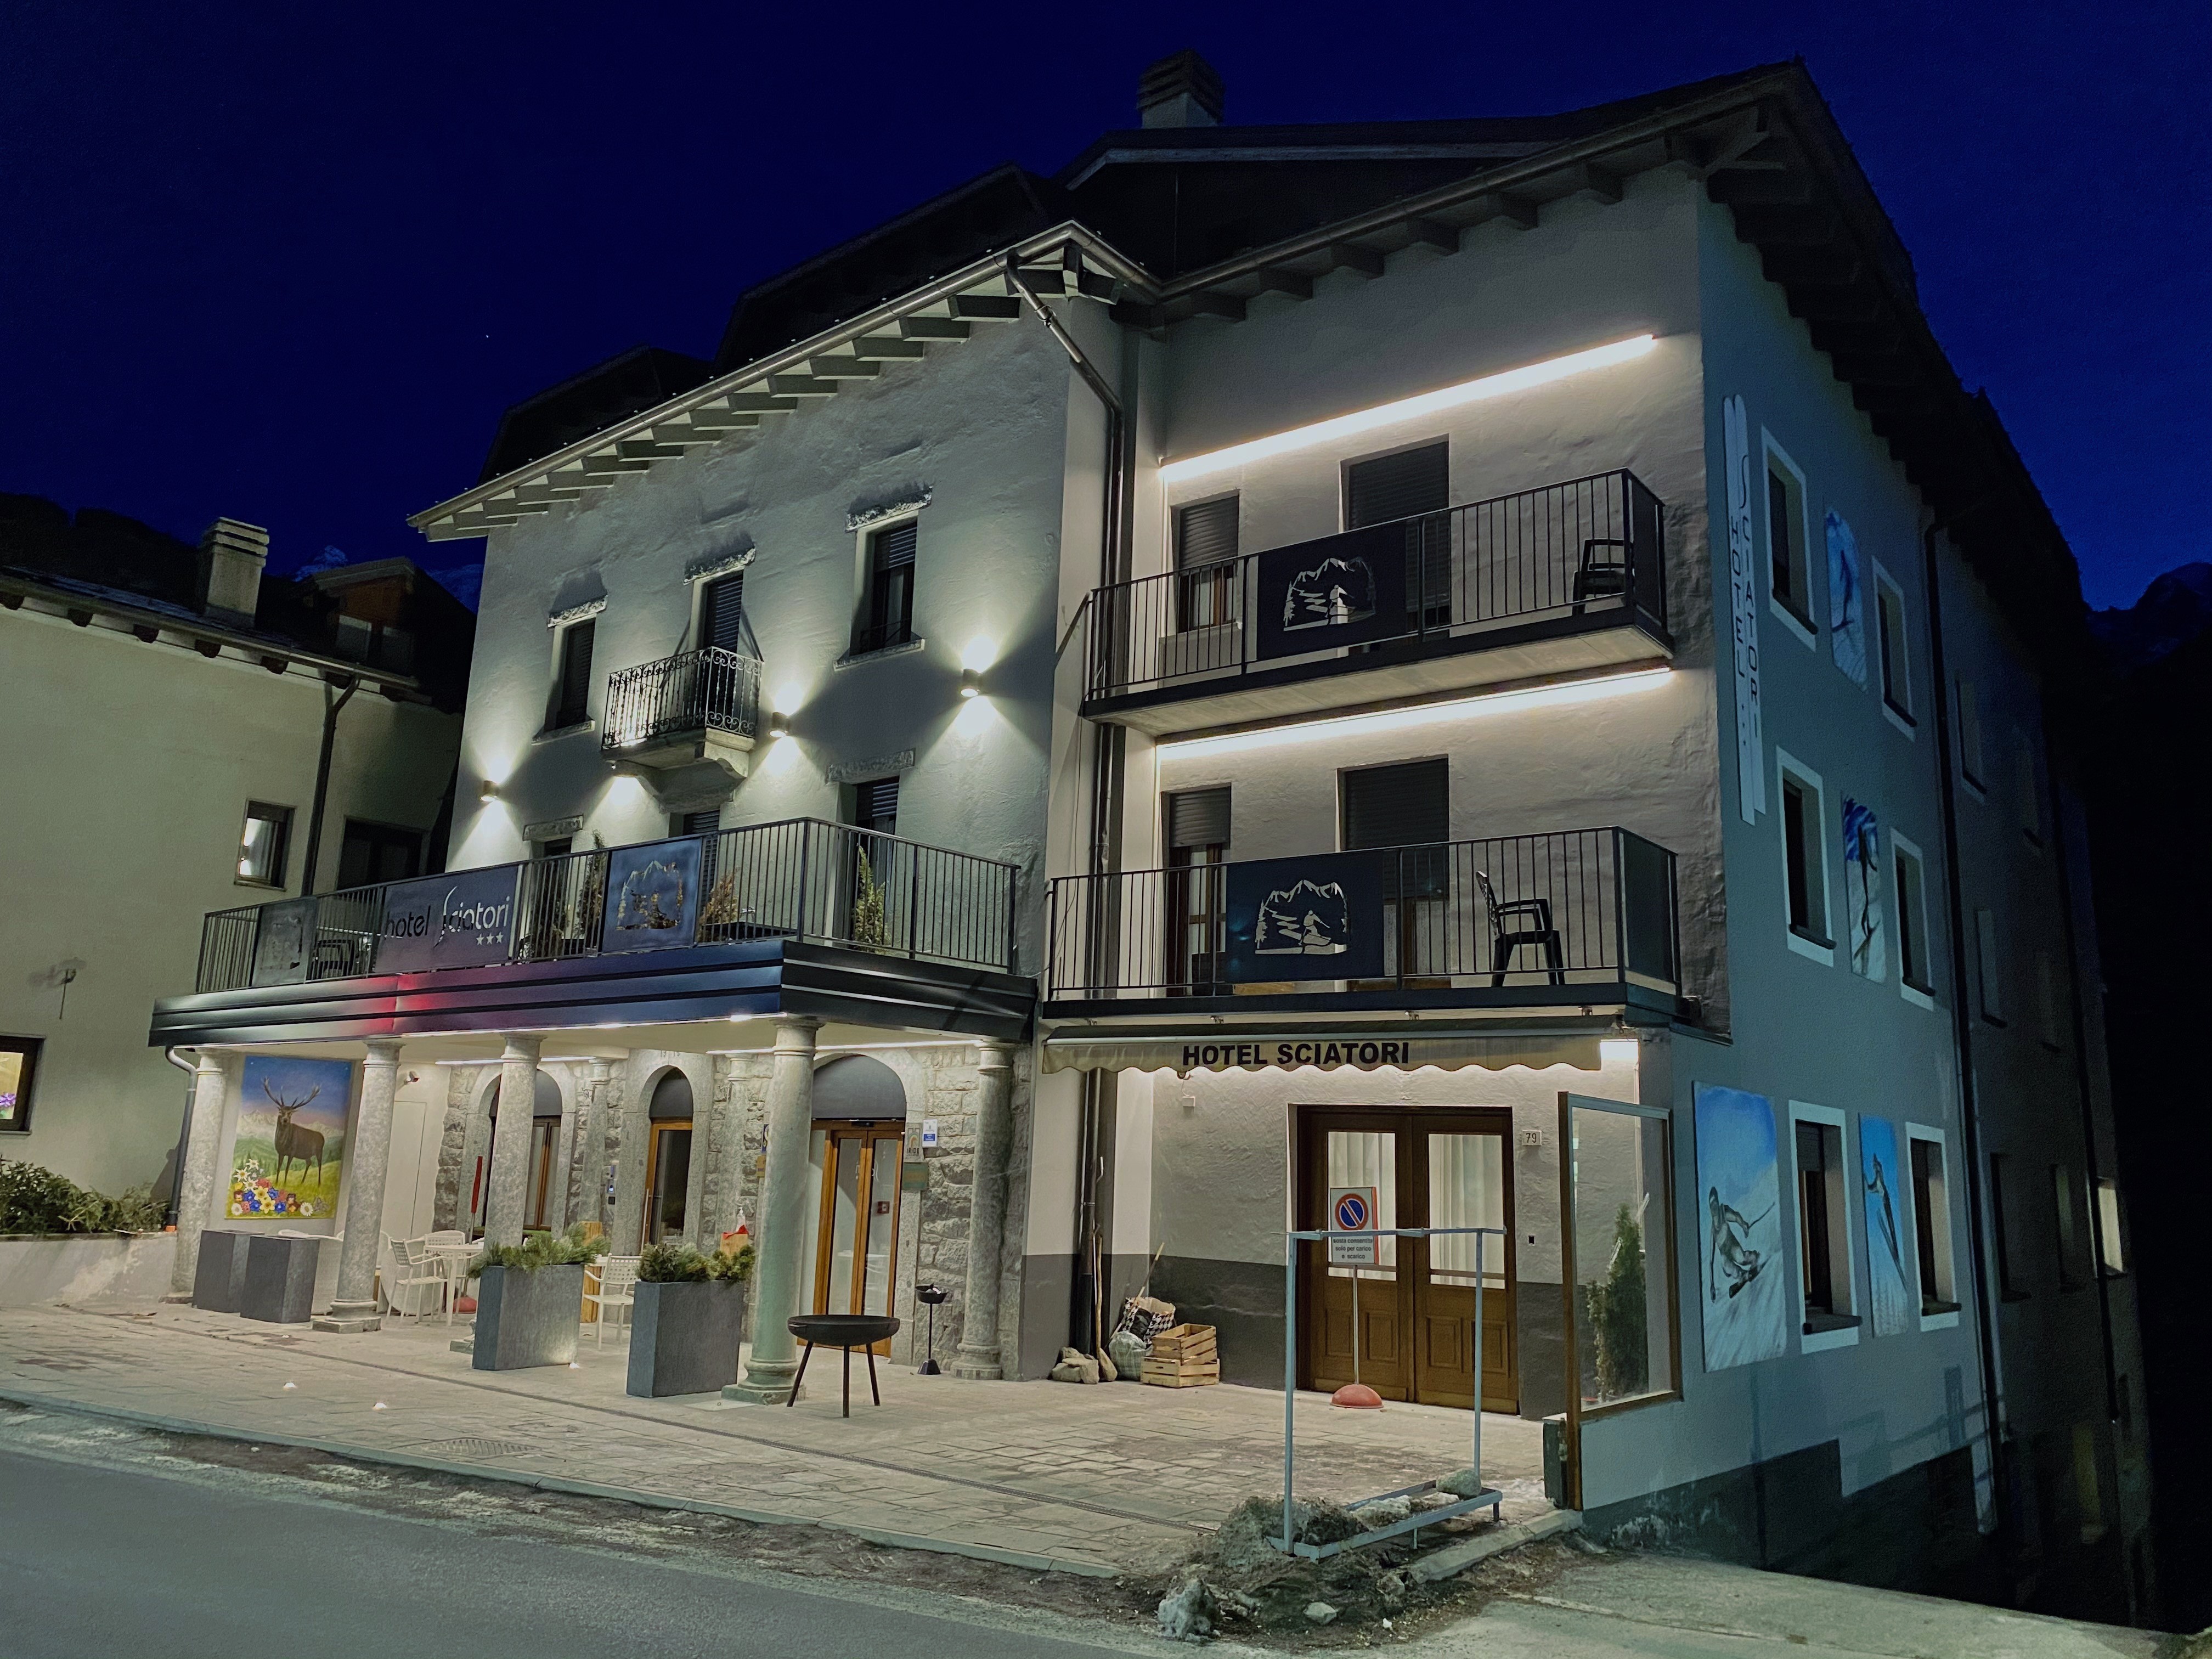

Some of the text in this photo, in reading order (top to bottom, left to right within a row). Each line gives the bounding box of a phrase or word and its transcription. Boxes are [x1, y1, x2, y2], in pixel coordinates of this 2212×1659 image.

[1730, 516, 1746, 678] HOTEL
[1739, 454, 1758, 738] SCIATORI
[385, 905, 431, 940] hotel
[1183, 1042, 1409, 1066] HOTEL SCIATORI
[1526, 1132, 1537, 1143] 79
